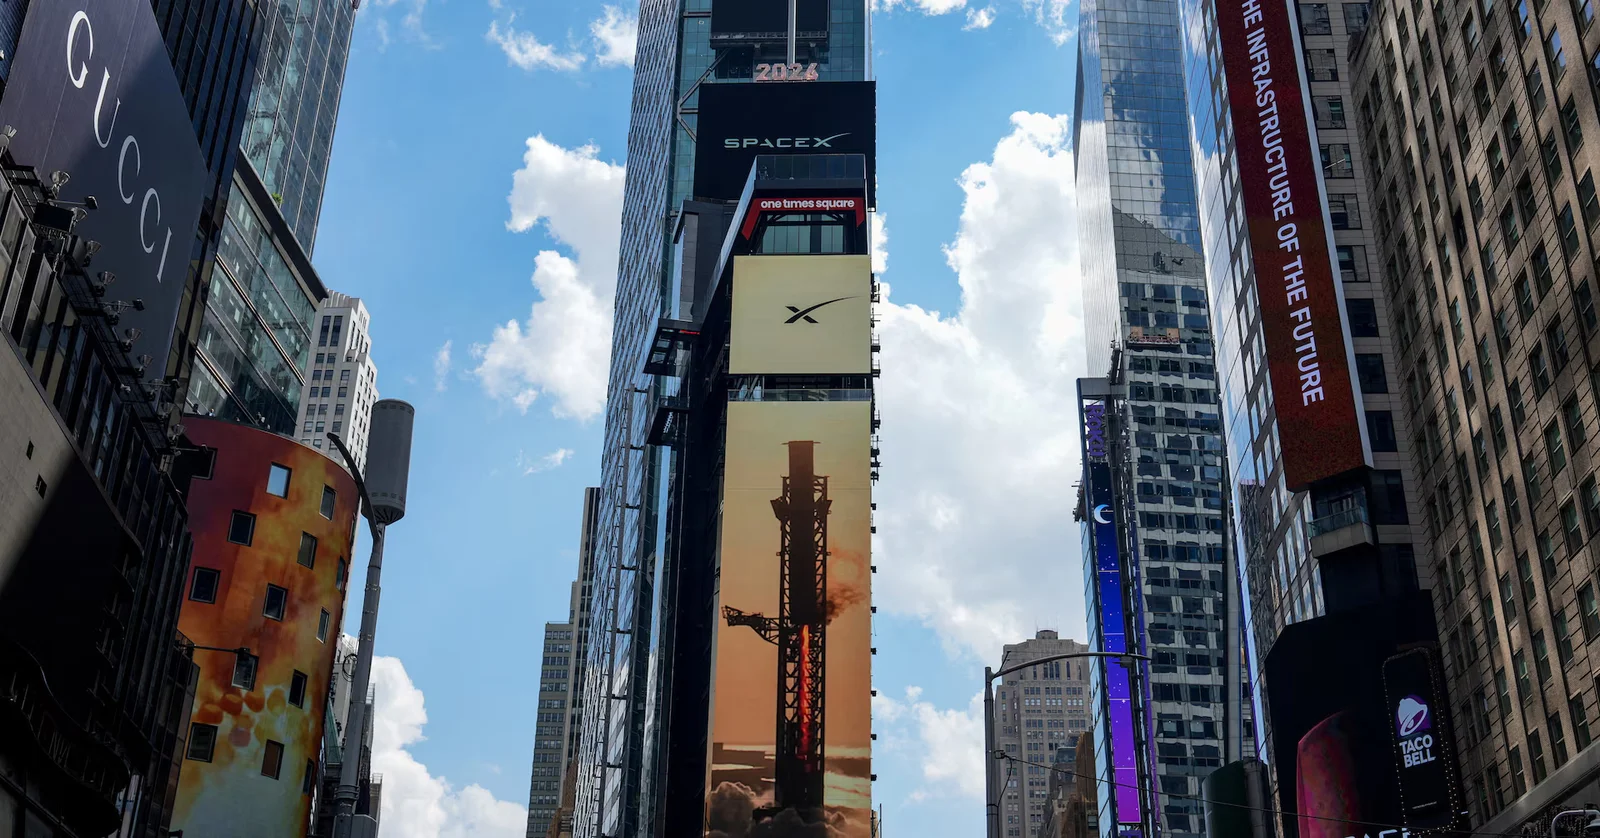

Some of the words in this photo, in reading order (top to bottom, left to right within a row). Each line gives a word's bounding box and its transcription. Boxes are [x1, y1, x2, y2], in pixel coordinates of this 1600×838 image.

[1241, 0, 1264, 29] HE
[755, 62, 819, 81] 2026
[1246, 27, 1295, 222] INFRASTRUCTURE
[66, 10, 172, 283] GUCCI
[724, 132, 852, 149] SPACEX
[760, 200, 782, 209] one
[783, 199, 815, 209] times
[815, 200, 855, 211] square
[1276, 223, 1300, 253] OF
[1282, 254, 1308, 306] THE
[1290, 306, 1325, 407] FUTURE
[1399, 734, 1433, 755] TACO
[1403, 749, 1436, 768] BELL
